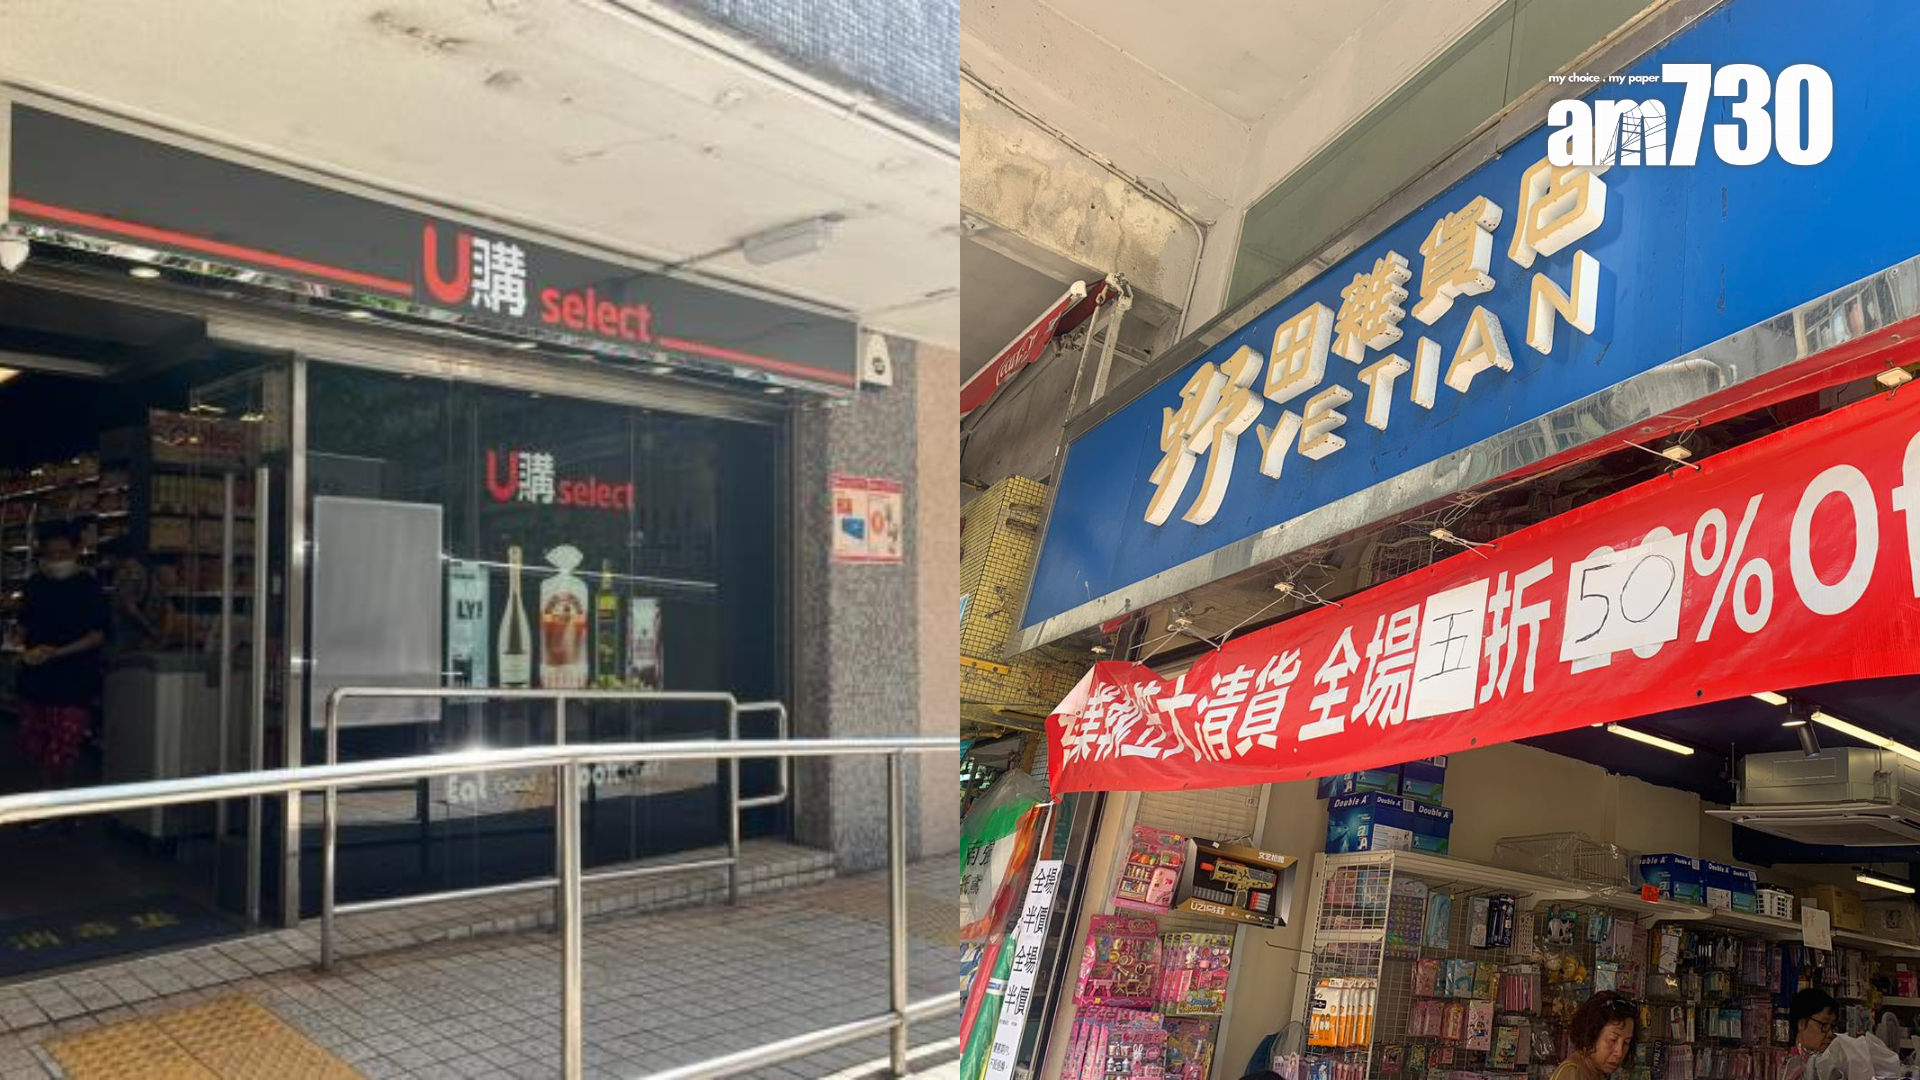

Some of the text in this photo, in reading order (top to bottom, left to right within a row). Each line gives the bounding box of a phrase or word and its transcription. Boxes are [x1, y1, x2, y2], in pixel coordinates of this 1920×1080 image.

[541, 287, 653, 344] select
[1256, 249, 1600, 480] YETIAN
[558, 477, 635, 509] select
[1334, 796, 1359, 808] Double
[1377, 796, 1396, 807] Double
[1418, 806, 1441, 817] Double
[1031, 867, 1058, 895] 全場
[1708, 863, 1725, 873] Double
[1013, 945, 1039, 974] 全場
